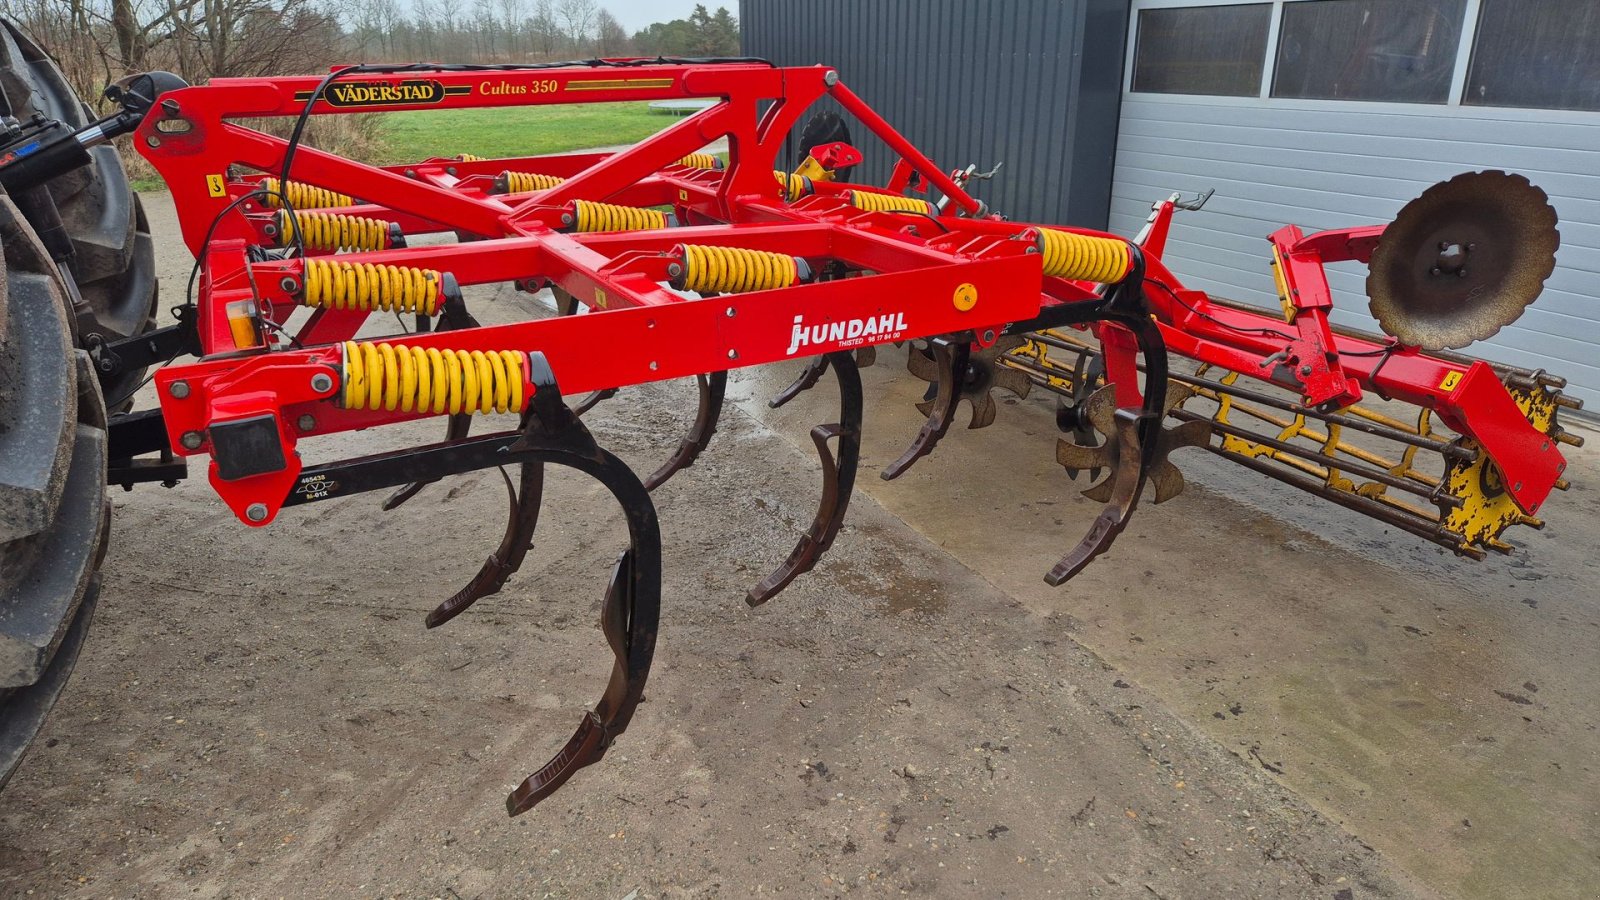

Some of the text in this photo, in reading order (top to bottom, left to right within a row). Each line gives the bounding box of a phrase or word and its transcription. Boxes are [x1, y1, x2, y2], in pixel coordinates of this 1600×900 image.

[334, 84, 434, 102] VÄDERSTAD
[479, 79, 558, 95] Cultus 350
[838, 338, 864, 348] THISTED
